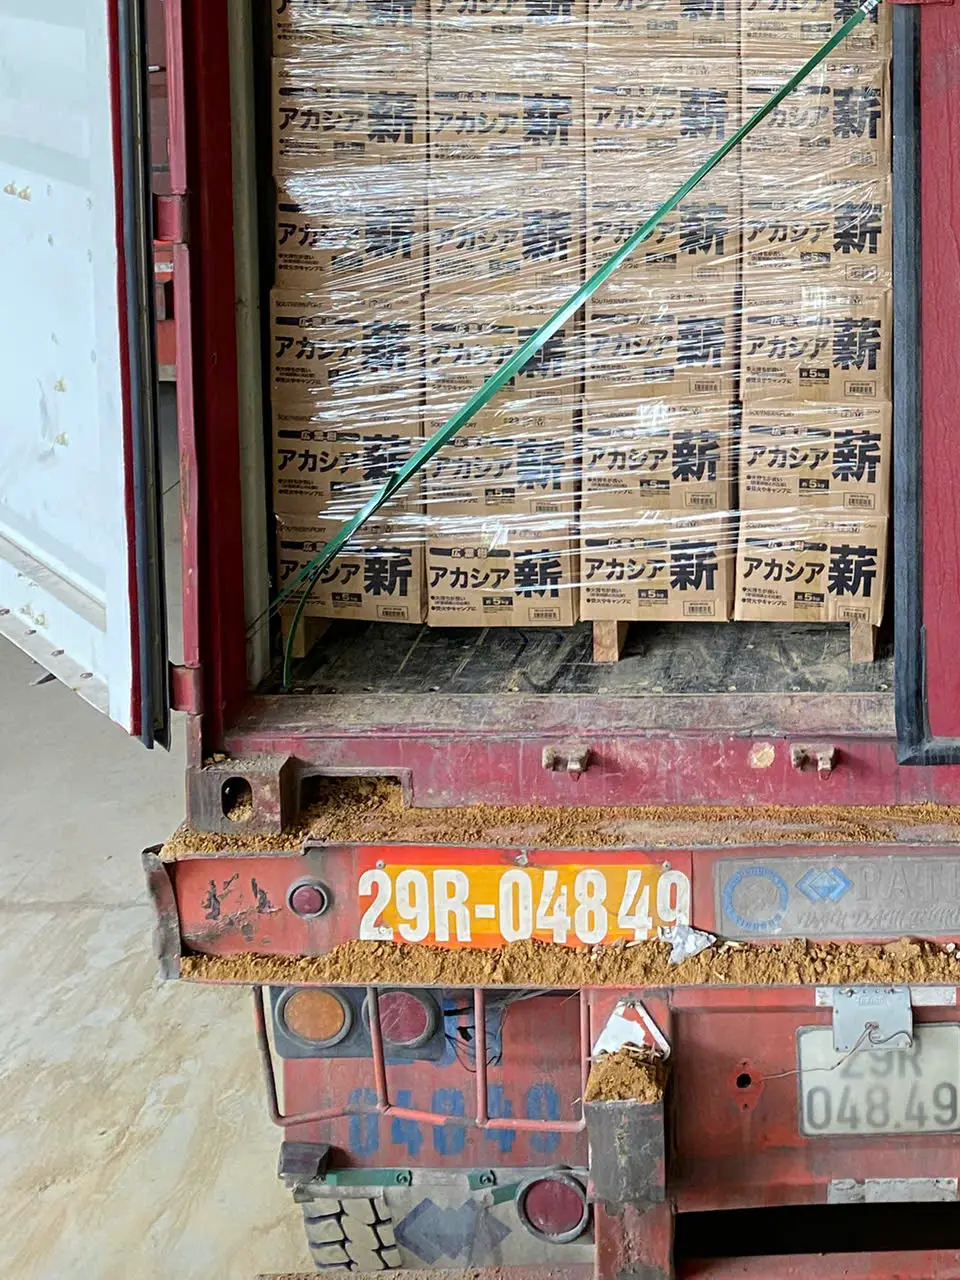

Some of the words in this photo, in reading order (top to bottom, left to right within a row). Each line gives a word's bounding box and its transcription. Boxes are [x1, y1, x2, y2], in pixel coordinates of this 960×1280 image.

[746, 336, 829, 360] アカシア
[832, 317, 881, 371] 薪
[672, 430, 721, 482] 薪
[746, 445, 829, 469] アカシア
[832, 429, 881, 483] 薪
[364, 547, 413, 596] 薪
[429, 566, 510, 589] アカシア
[513, 547, 563, 598] 薪
[584, 557, 667, 580] アカシア
[670, 539, 718, 591] 薪
[743, 556, 825, 585] アカシア
[827, 544, 877, 597] 薪
